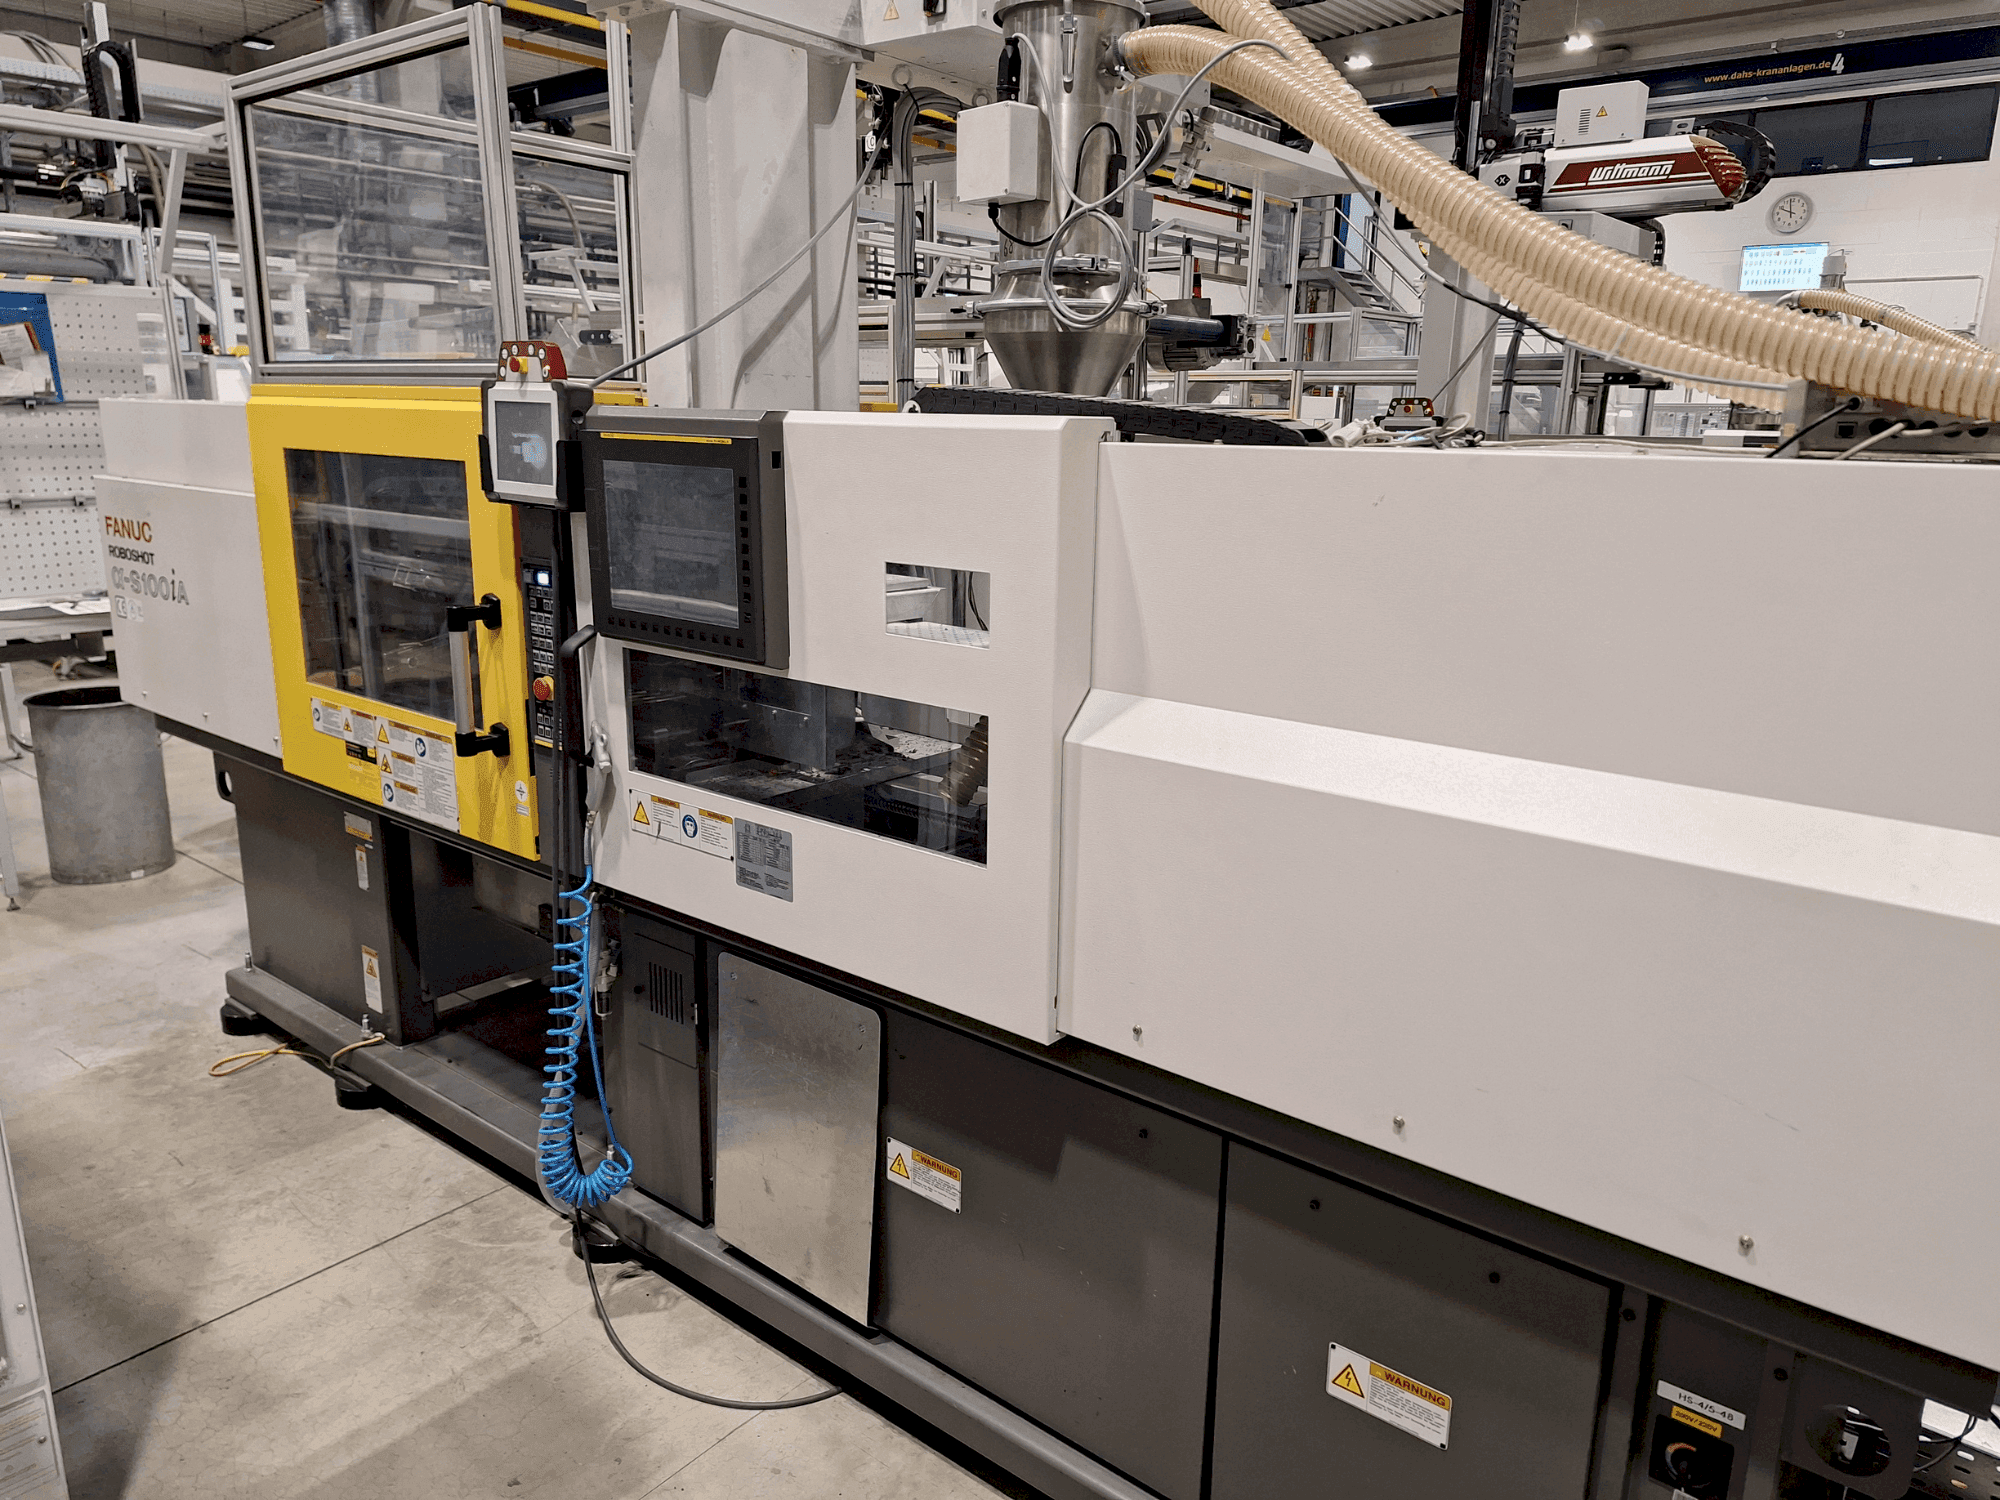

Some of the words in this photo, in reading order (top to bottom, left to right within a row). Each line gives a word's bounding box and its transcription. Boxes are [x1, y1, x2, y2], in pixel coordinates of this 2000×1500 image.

[1704, 60, 1831, 83] www.dahs-krananlagen.de
[1588, 161, 1675, 181] Wittmann
[105, 516, 152, 543] FANUC
[108, 545, 155, 565] ROBOSHOT
[920, 1155, 958, 1178] WARNUNG
[1384, 1371, 1446, 1407] WARNUNG
